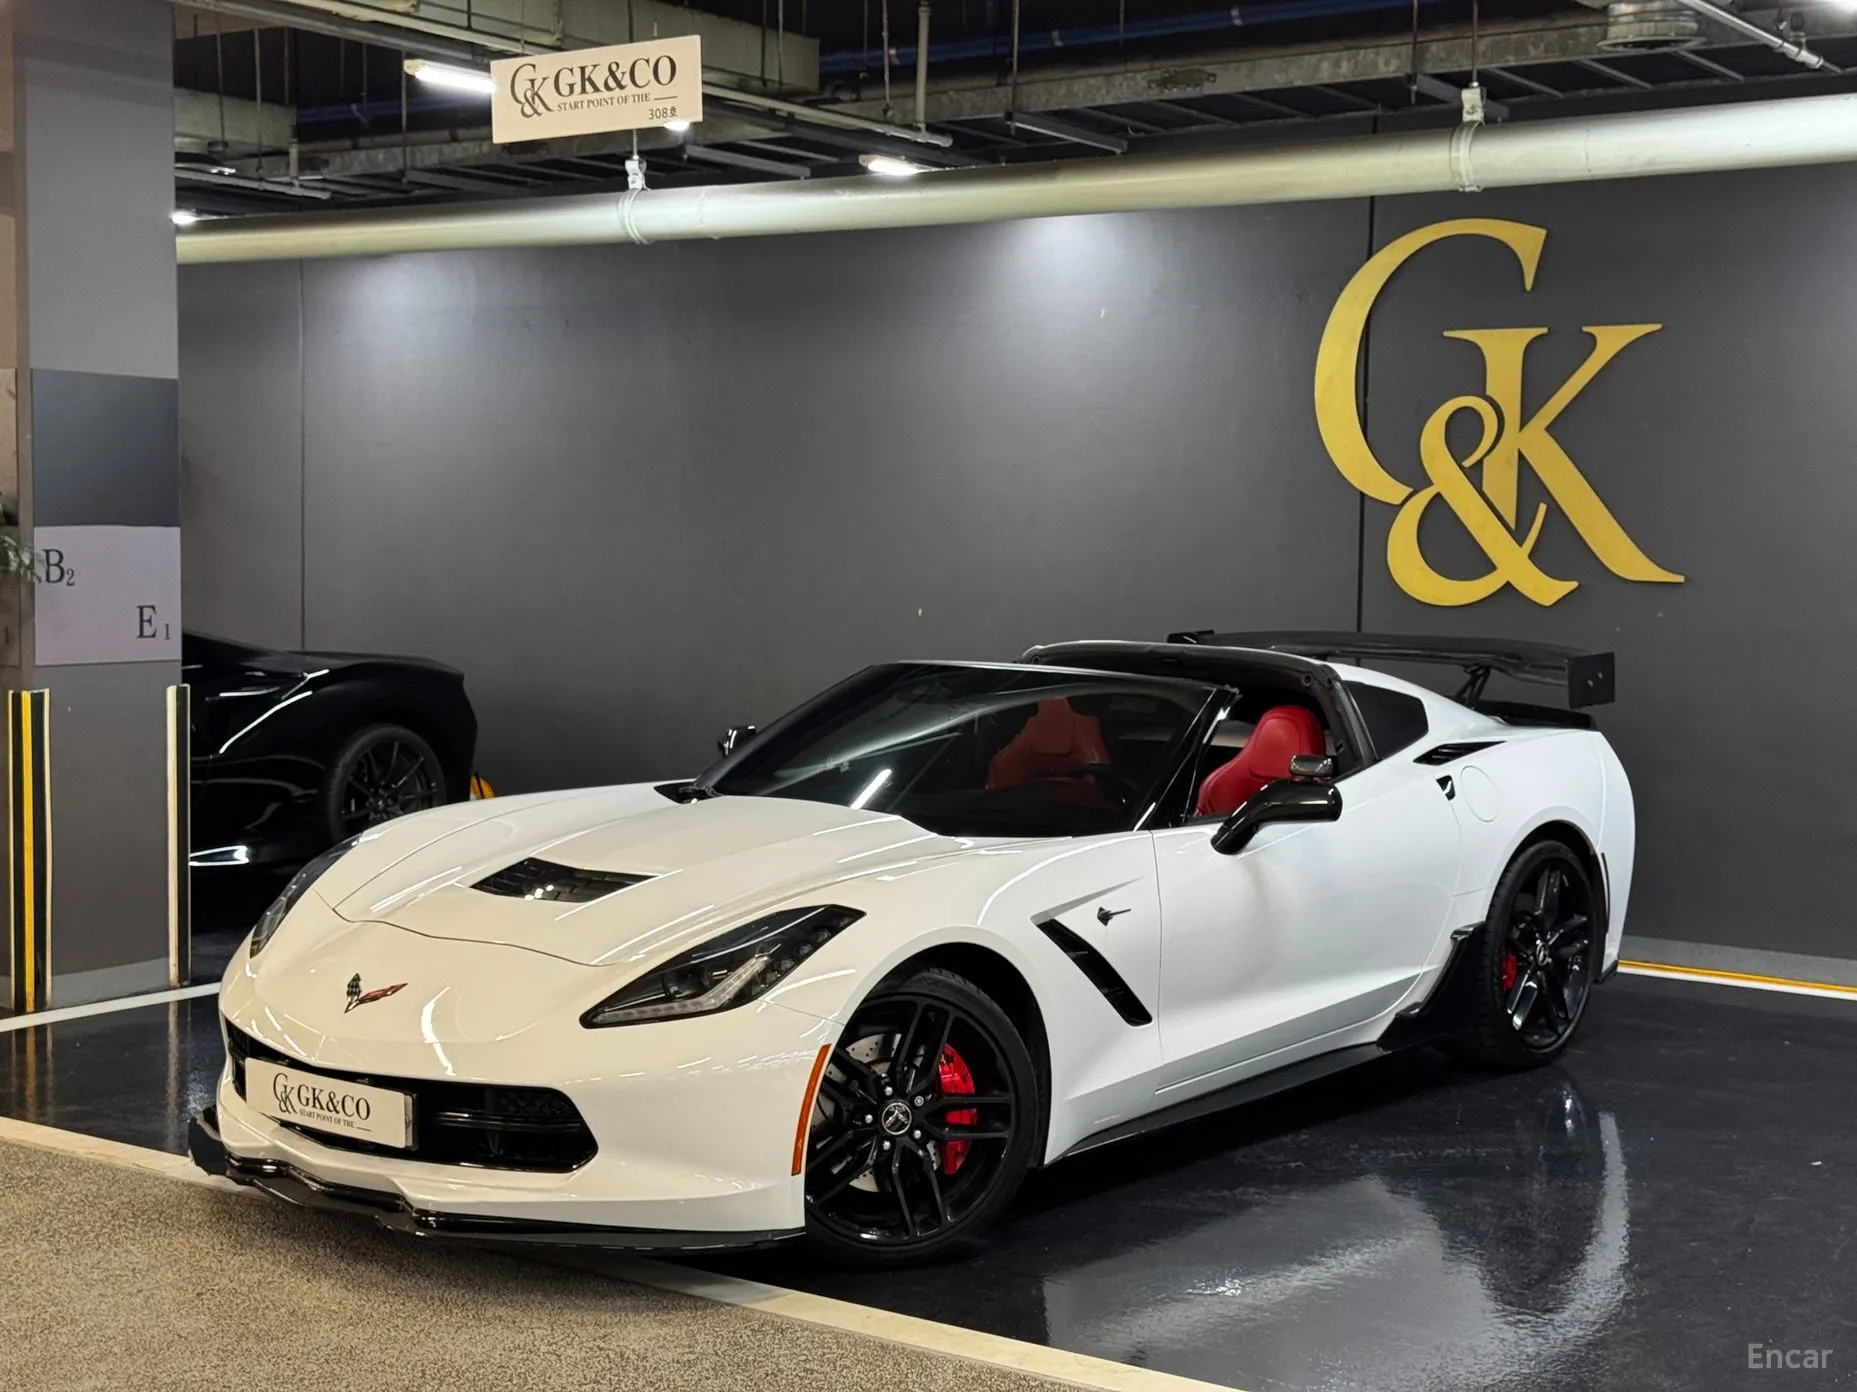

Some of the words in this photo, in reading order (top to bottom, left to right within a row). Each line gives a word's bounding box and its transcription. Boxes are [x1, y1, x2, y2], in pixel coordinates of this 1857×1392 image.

[553, 55, 677, 97] GK&CO
[557, 100, 584, 112] START
[587, 97, 615, 109] POINT
[617, 95, 629, 106] OF
[632, 93, 651, 103] THE
[648, 106, 678, 120] 308호
[297, 1083, 371, 1121] GK&CO
[300, 1109, 315, 1119] START
[316, 1113, 333, 1123] POINT
[333, 1117, 342, 1125] OF
[343, 1119, 355, 1128] THE
